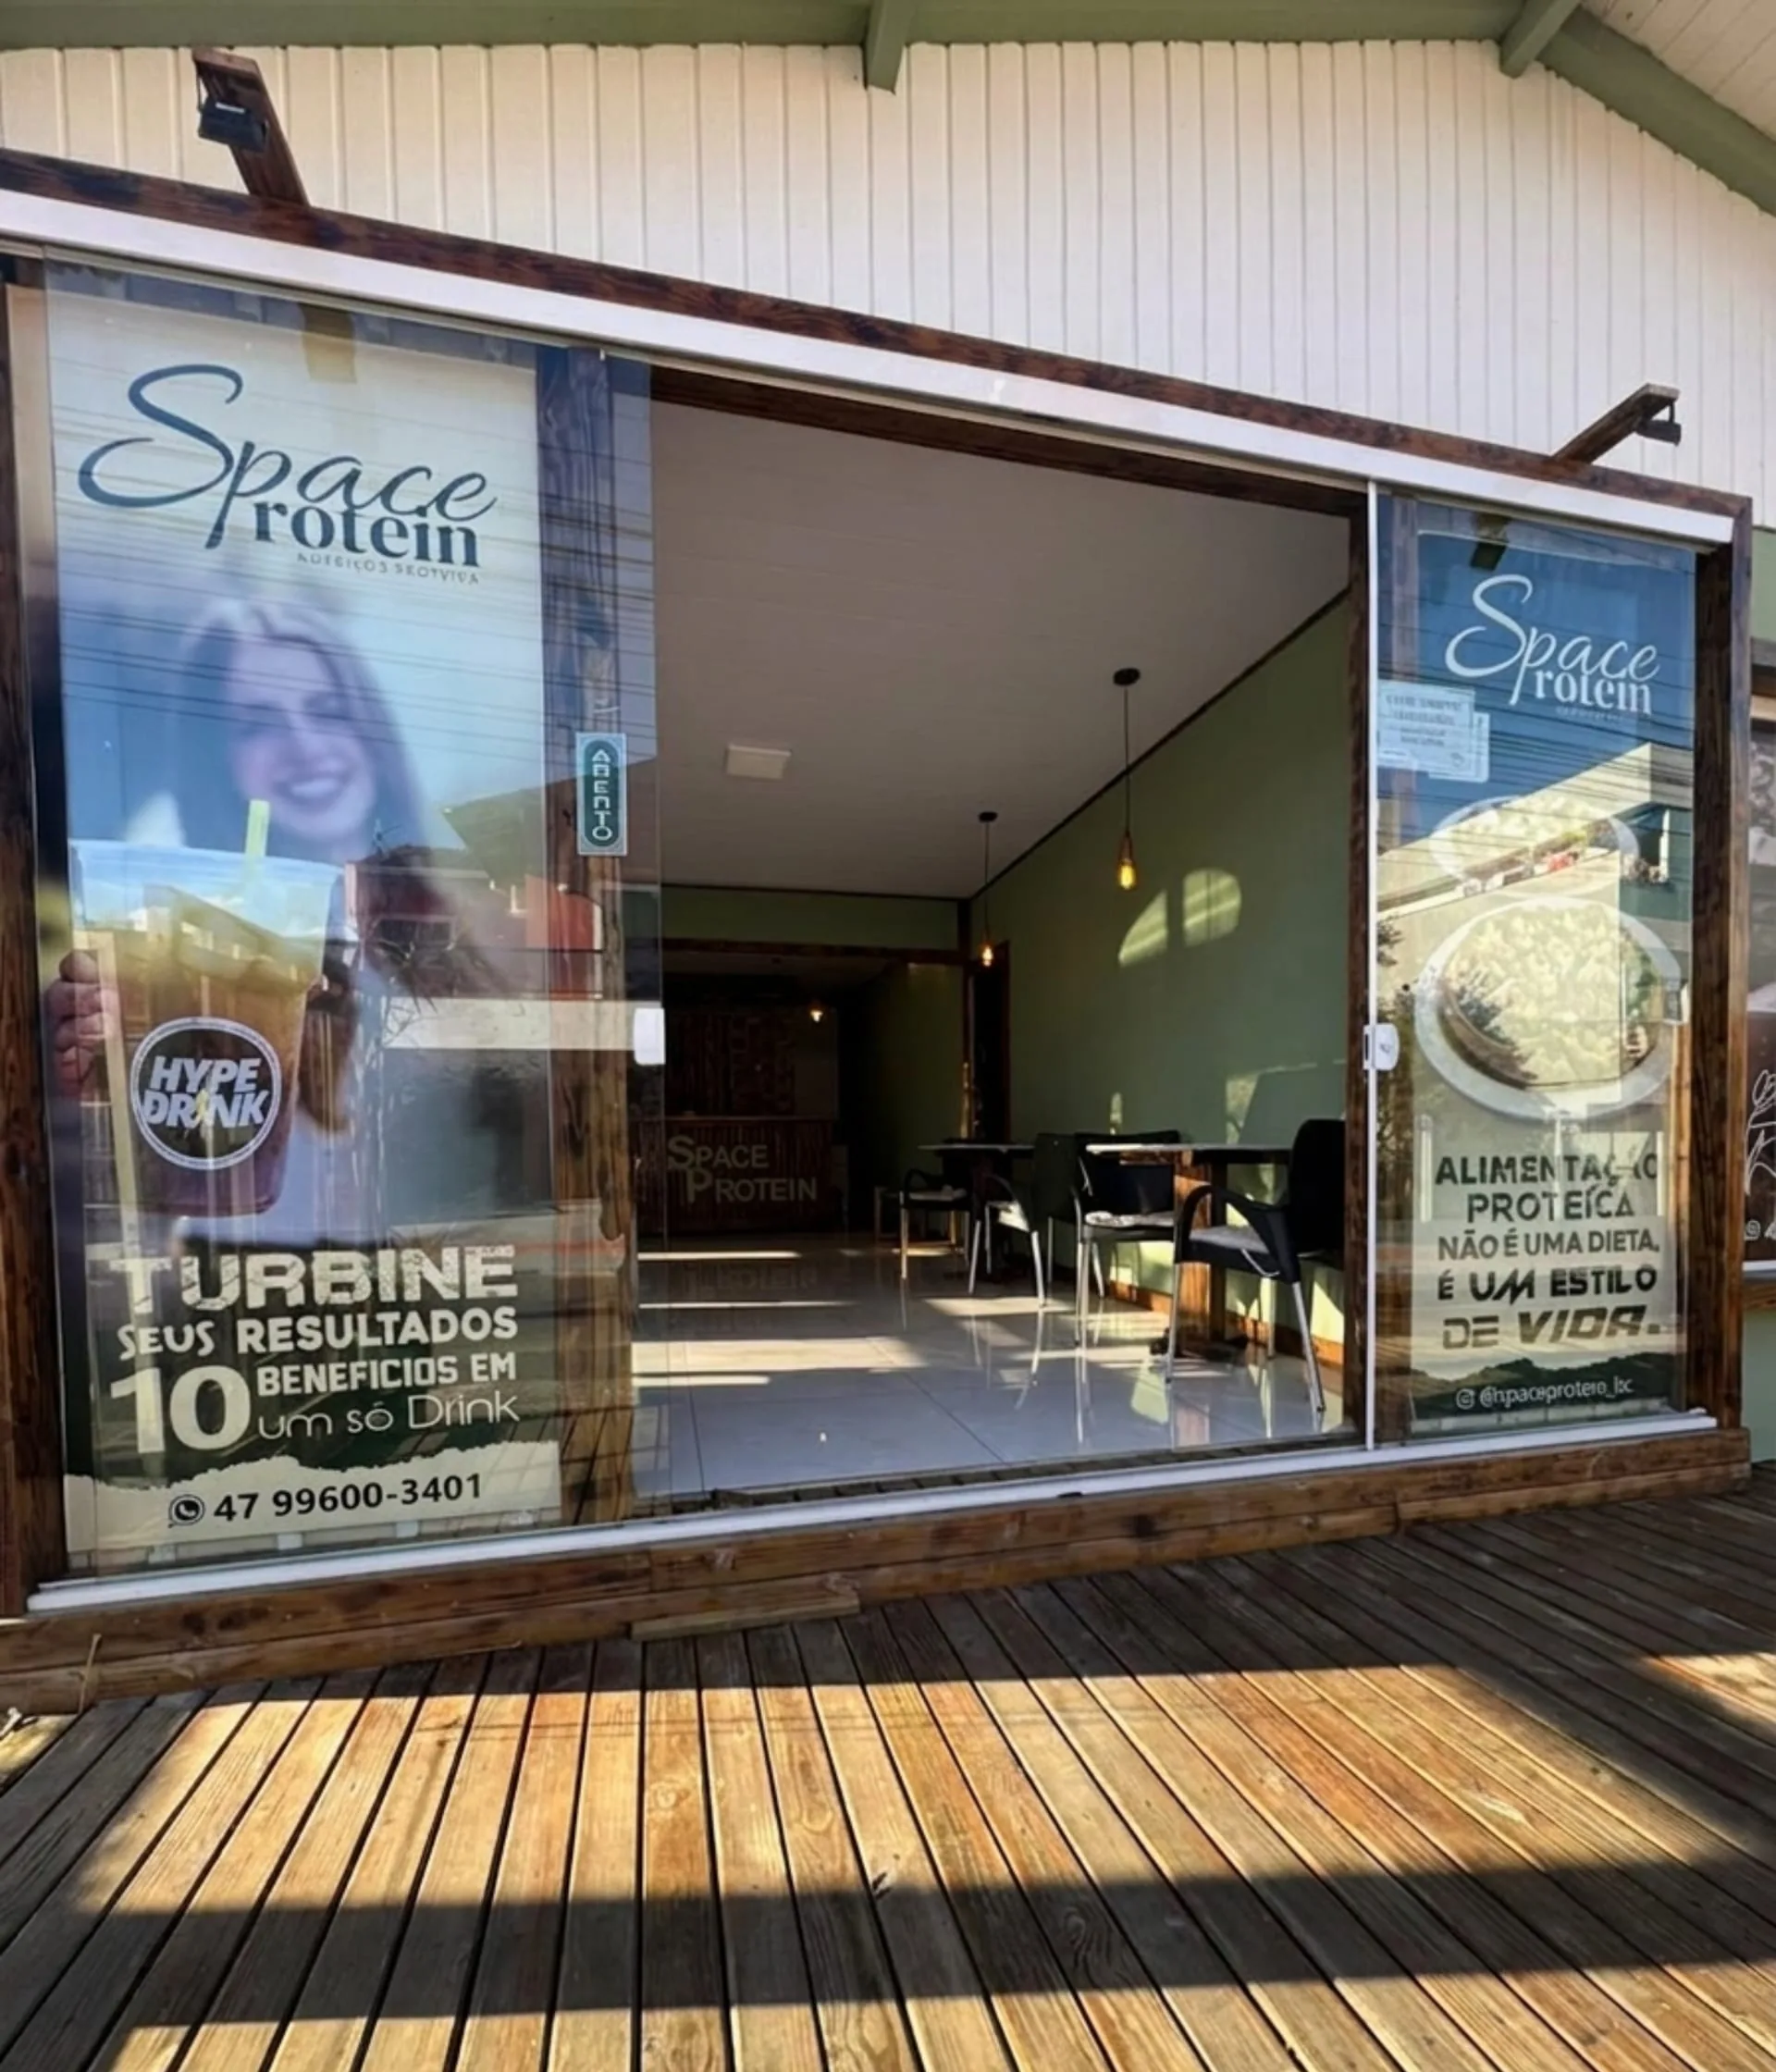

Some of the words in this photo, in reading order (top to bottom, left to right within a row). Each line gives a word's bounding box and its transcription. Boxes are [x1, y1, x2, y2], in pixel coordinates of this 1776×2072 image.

[78, 364, 498, 549] Space
[1445, 574, 1661, 706] Space
[150, 1055, 262, 1094] HYPE
[668, 1135, 770, 1169] SPACE
[685, 1166, 818, 1203] PROTEIN
[1438, 1229, 1499, 1261] NÃO
[1503, 1228, 1519, 1257] É
[1525, 1232, 1584, 1255] UMA
[109, 1243, 518, 1314] TURBINE
[1437, 1268, 1454, 1301] É
[1470, 1268, 1536, 1306] UM
[1550, 1264, 1658, 1297] ESTILO
[117, 1320, 215, 1360] SEUS
[237, 1306, 518, 1354] RESULTADOS
[1443, 1314, 1499, 1350] DE
[111, 1365, 251, 1454] 10
[257, 1357, 459, 1397] BENEFICIOS
[471, 1353, 516, 1383] EM
[258, 1412, 332, 1440] um
[347, 1402, 394, 1432] só
[408, 1390, 520, 1430] Drink
[214, 1494, 259, 1521] 47
[272, 1473, 482, 1518] 99600-3401
